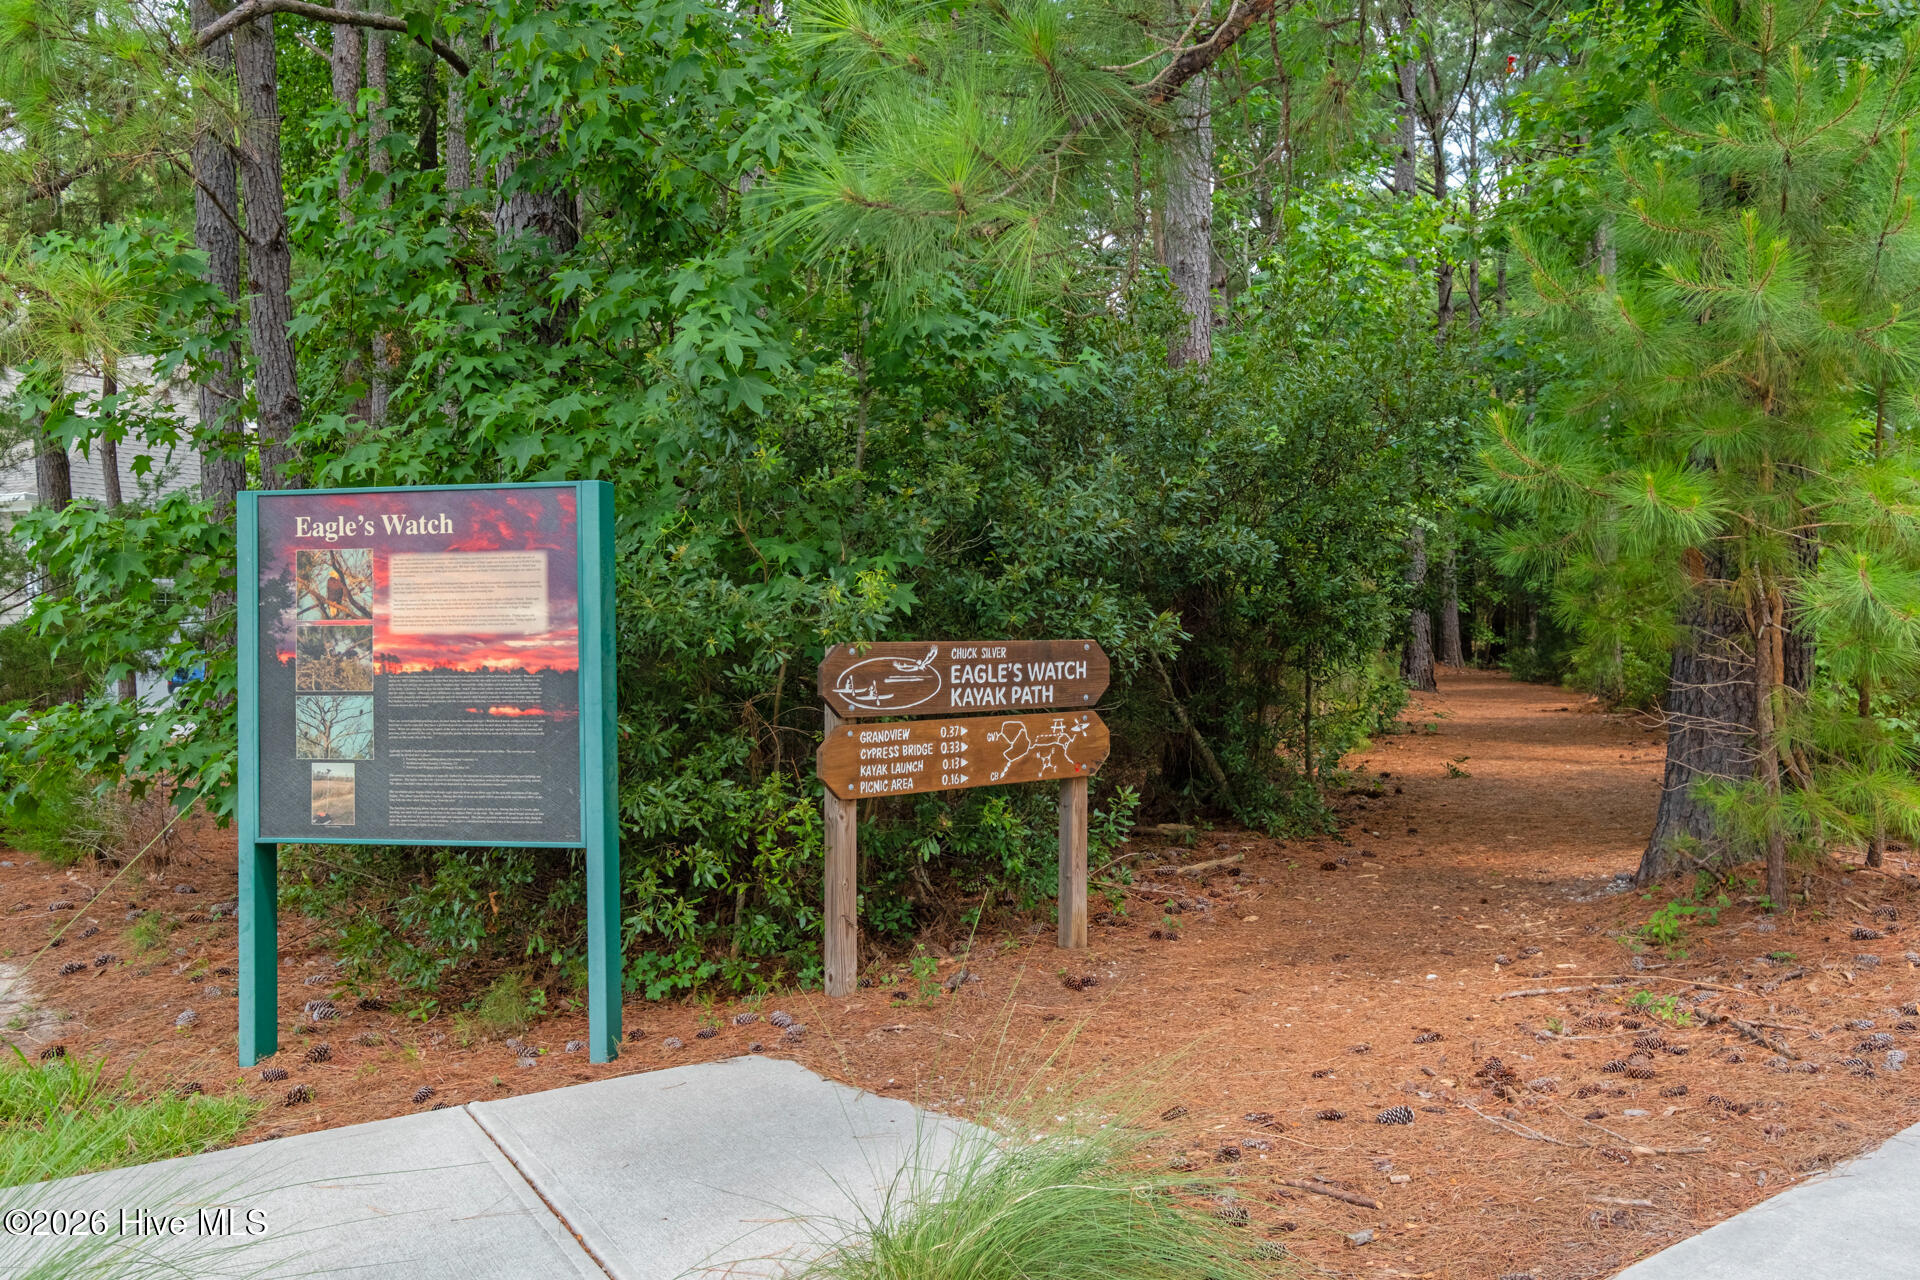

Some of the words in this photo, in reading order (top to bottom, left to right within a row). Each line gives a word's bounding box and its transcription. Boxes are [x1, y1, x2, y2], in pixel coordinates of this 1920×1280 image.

[295, 515, 375, 543] Eagle's
[381, 513, 453, 536] Watch
[951, 647, 978, 660] CHUCK
[981, 646, 1007, 659] SILVER
[951, 662, 1023, 684] EAGLE'S
[1027, 660, 1087, 681] WATCH
[951, 686, 1007, 707] KAYAK
[1011, 684, 1054, 704] PATH
[859, 728, 911, 744] GRANDVIEW
[940, 725, 959, 738] 0.37
[860, 745, 900, 760] CYPRESS
[902, 743, 934, 756] BRIDGE
[940, 741, 960, 754] 0.33
[860, 764, 888, 777] KAYAK
[891, 759, 924, 774] LAUNCH
[942, 757, 960, 770] 0.13
[860, 779, 889, 794] PICNIC
[890, 777, 914, 792] AREA
[941, 773, 960, 786] 0.16
